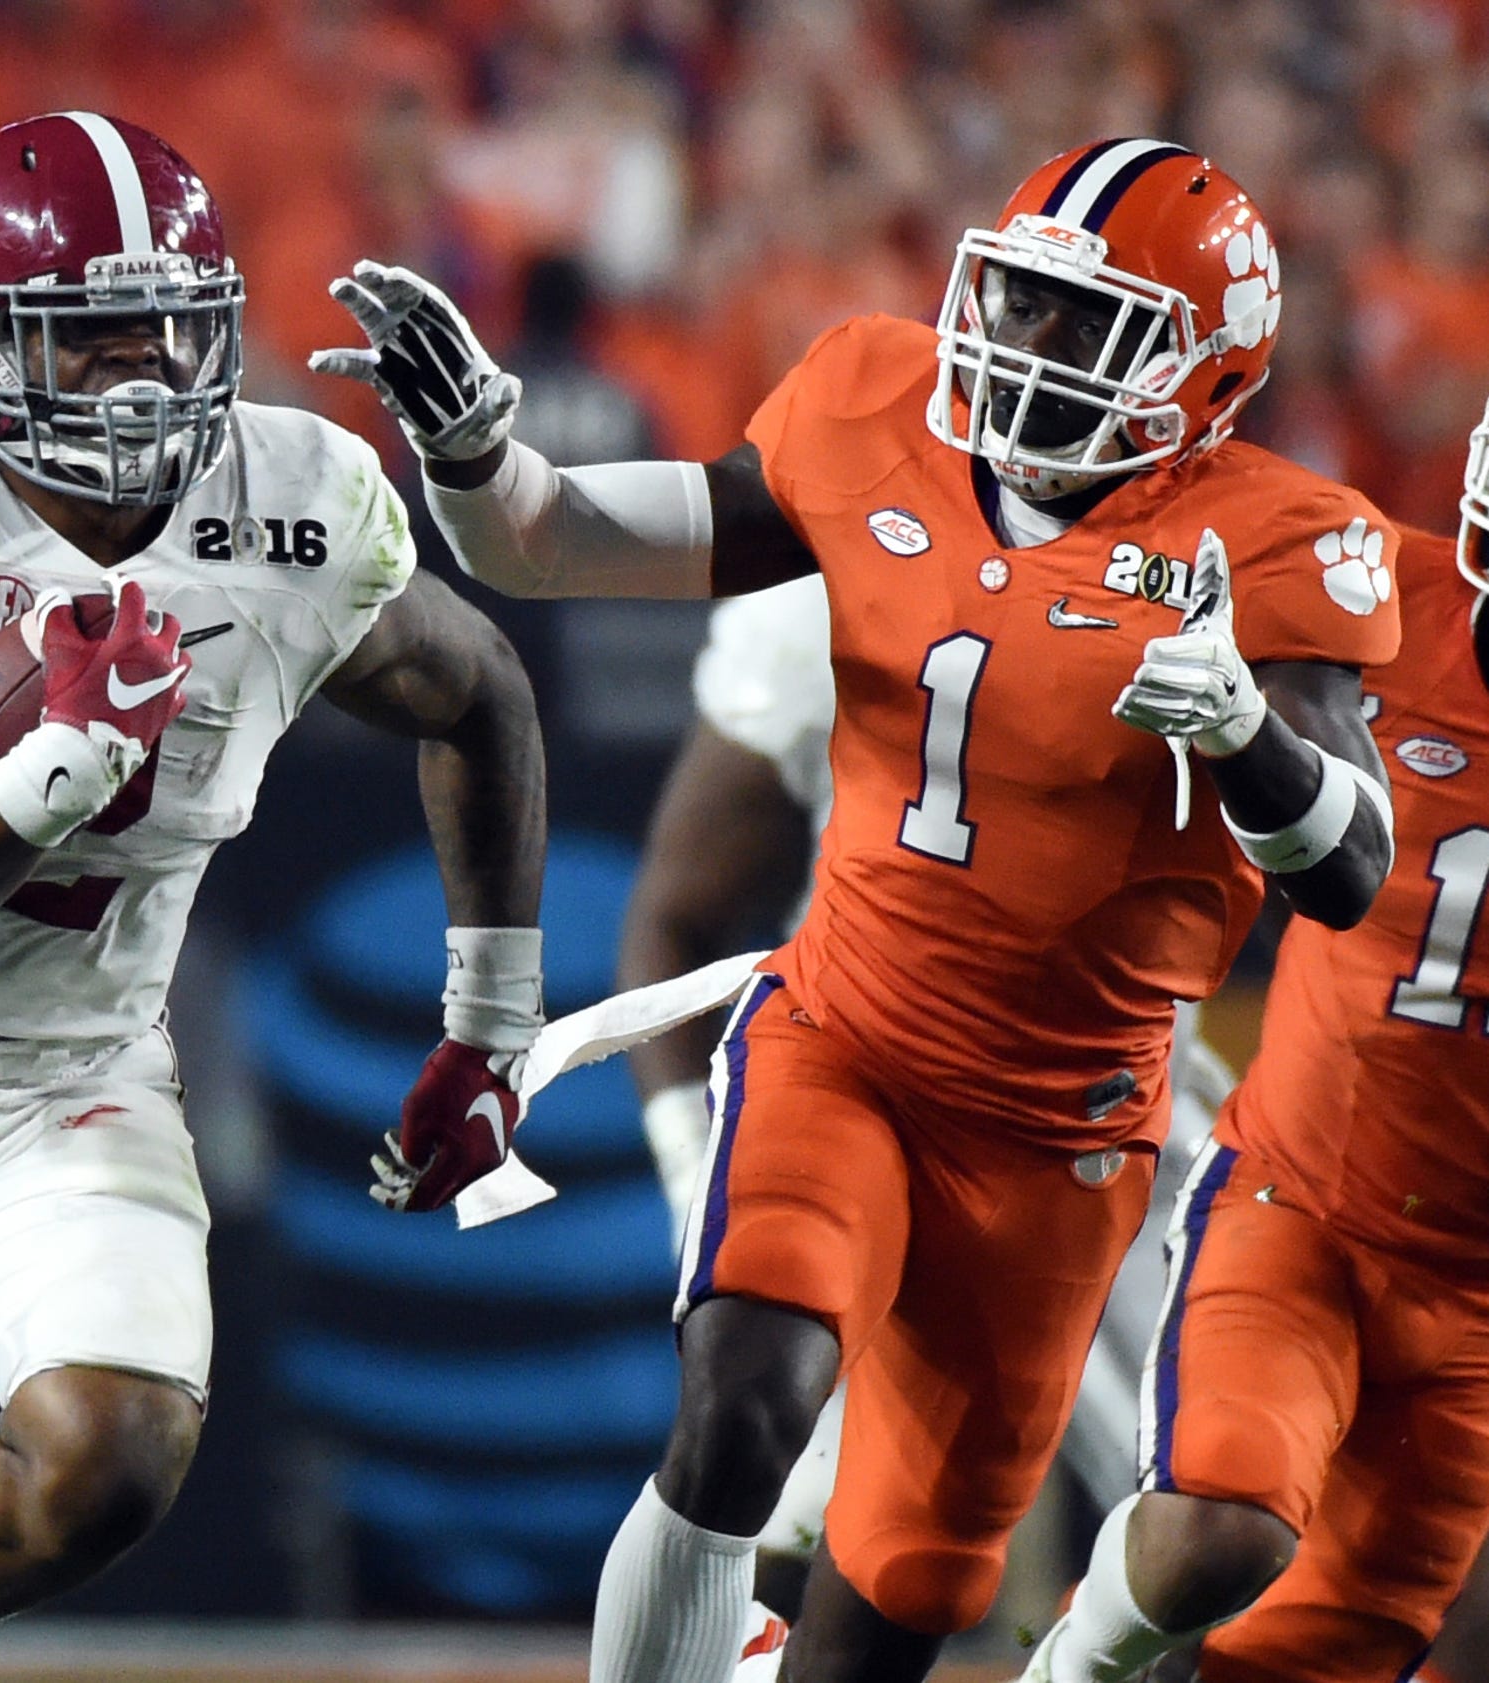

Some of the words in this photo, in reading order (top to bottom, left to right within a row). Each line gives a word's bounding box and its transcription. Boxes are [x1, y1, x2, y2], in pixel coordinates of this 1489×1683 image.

[1035, 226, 1082, 245] ACC
[114, 261, 165, 277] BAMA
[875, 519, 928, 545] ACC
[1103, 542, 1192, 612] 201
[898, 631, 991, 866] 1
[1405, 745, 1462, 767] ACC
